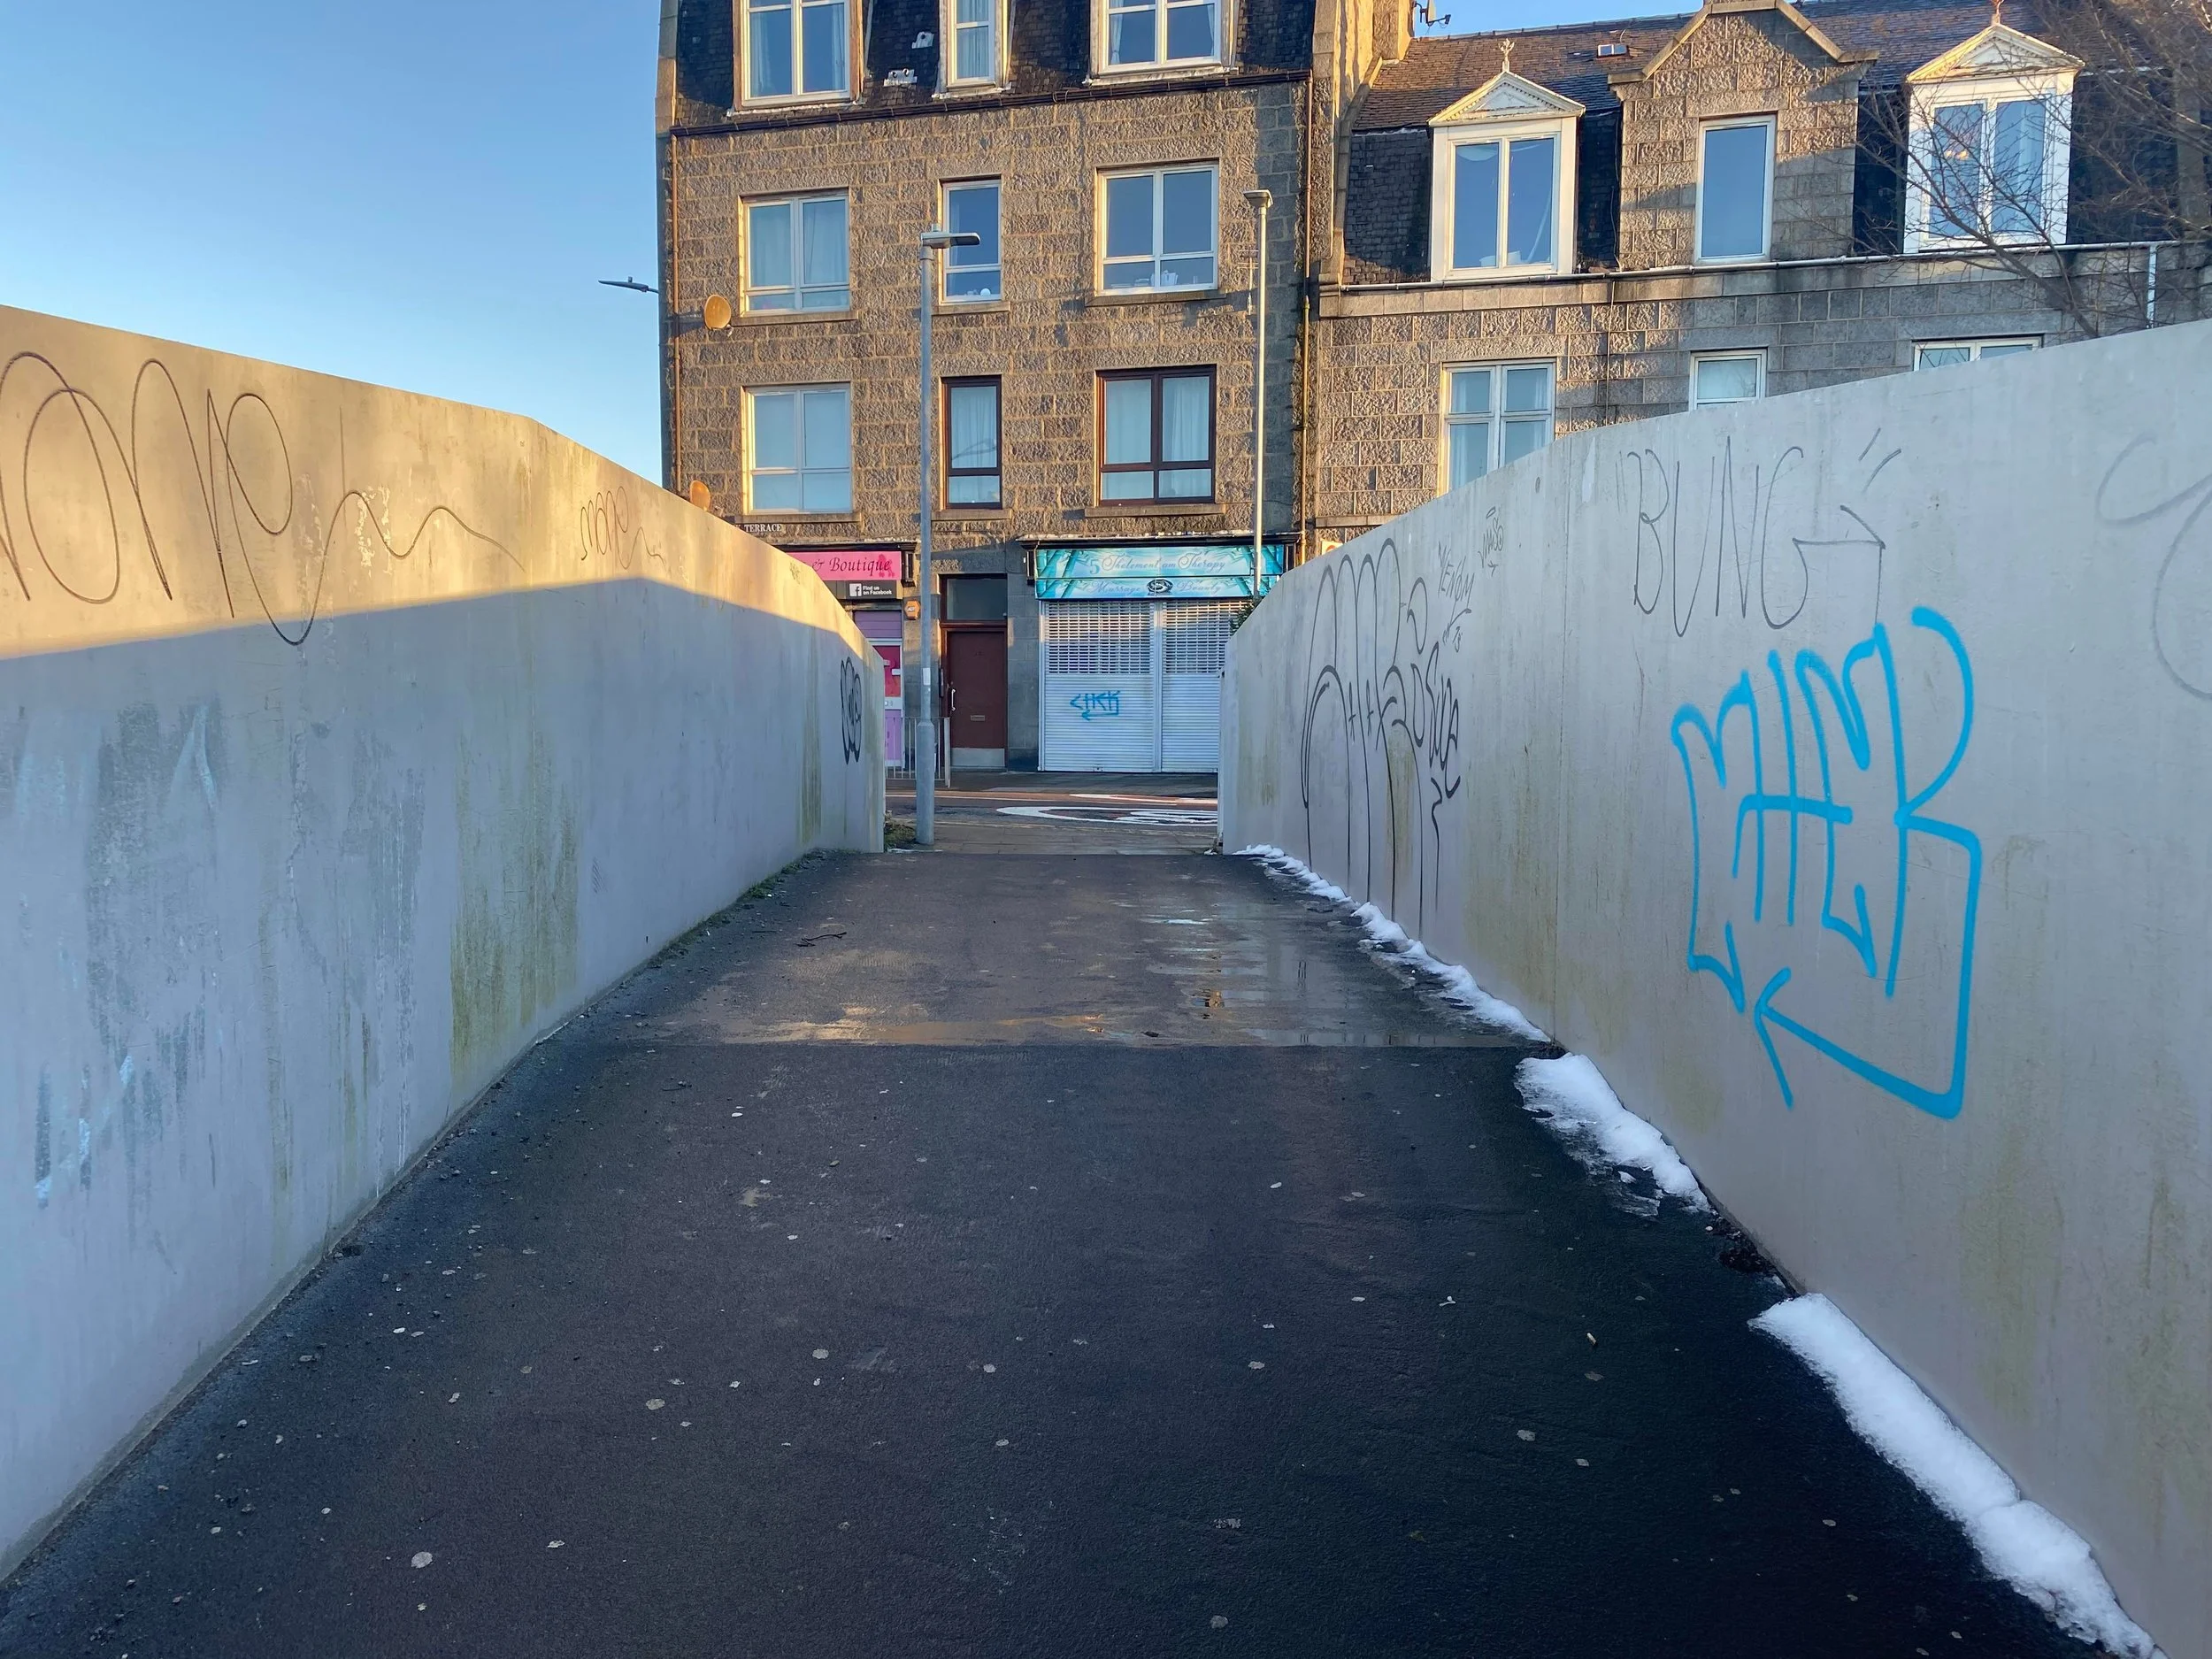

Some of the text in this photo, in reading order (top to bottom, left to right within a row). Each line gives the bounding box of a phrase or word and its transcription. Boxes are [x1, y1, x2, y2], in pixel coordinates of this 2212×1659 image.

[744, 523, 781, 533] TERRACE
[829, 557, 890, 576] Boutique
[1089, 558, 1100, 575] 5
[1178, 551, 1226, 572] Therapy
[1091, 580, 1141, 595] Massage
